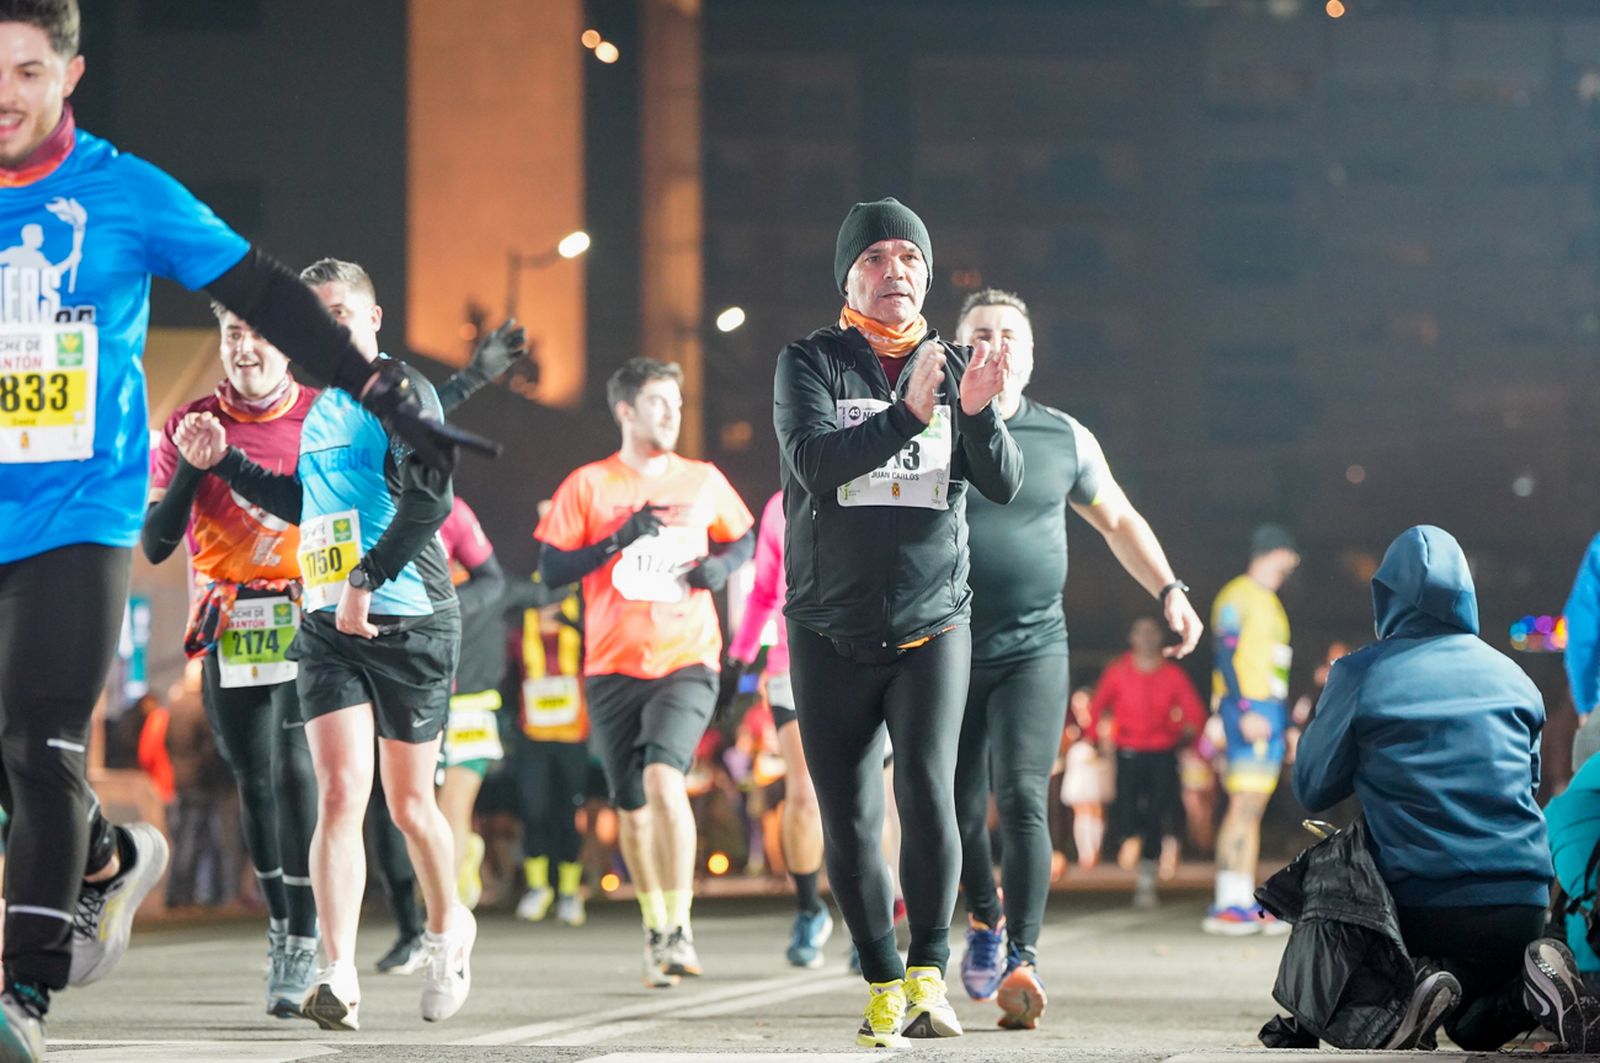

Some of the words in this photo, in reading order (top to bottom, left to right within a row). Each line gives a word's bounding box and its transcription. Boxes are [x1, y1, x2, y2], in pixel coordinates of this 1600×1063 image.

[0, 373, 68, 412] 833
[871, 471, 890, 479] JUAN
[891, 471, 920, 481] CARLOS
[232, 629, 280, 656] 2174
